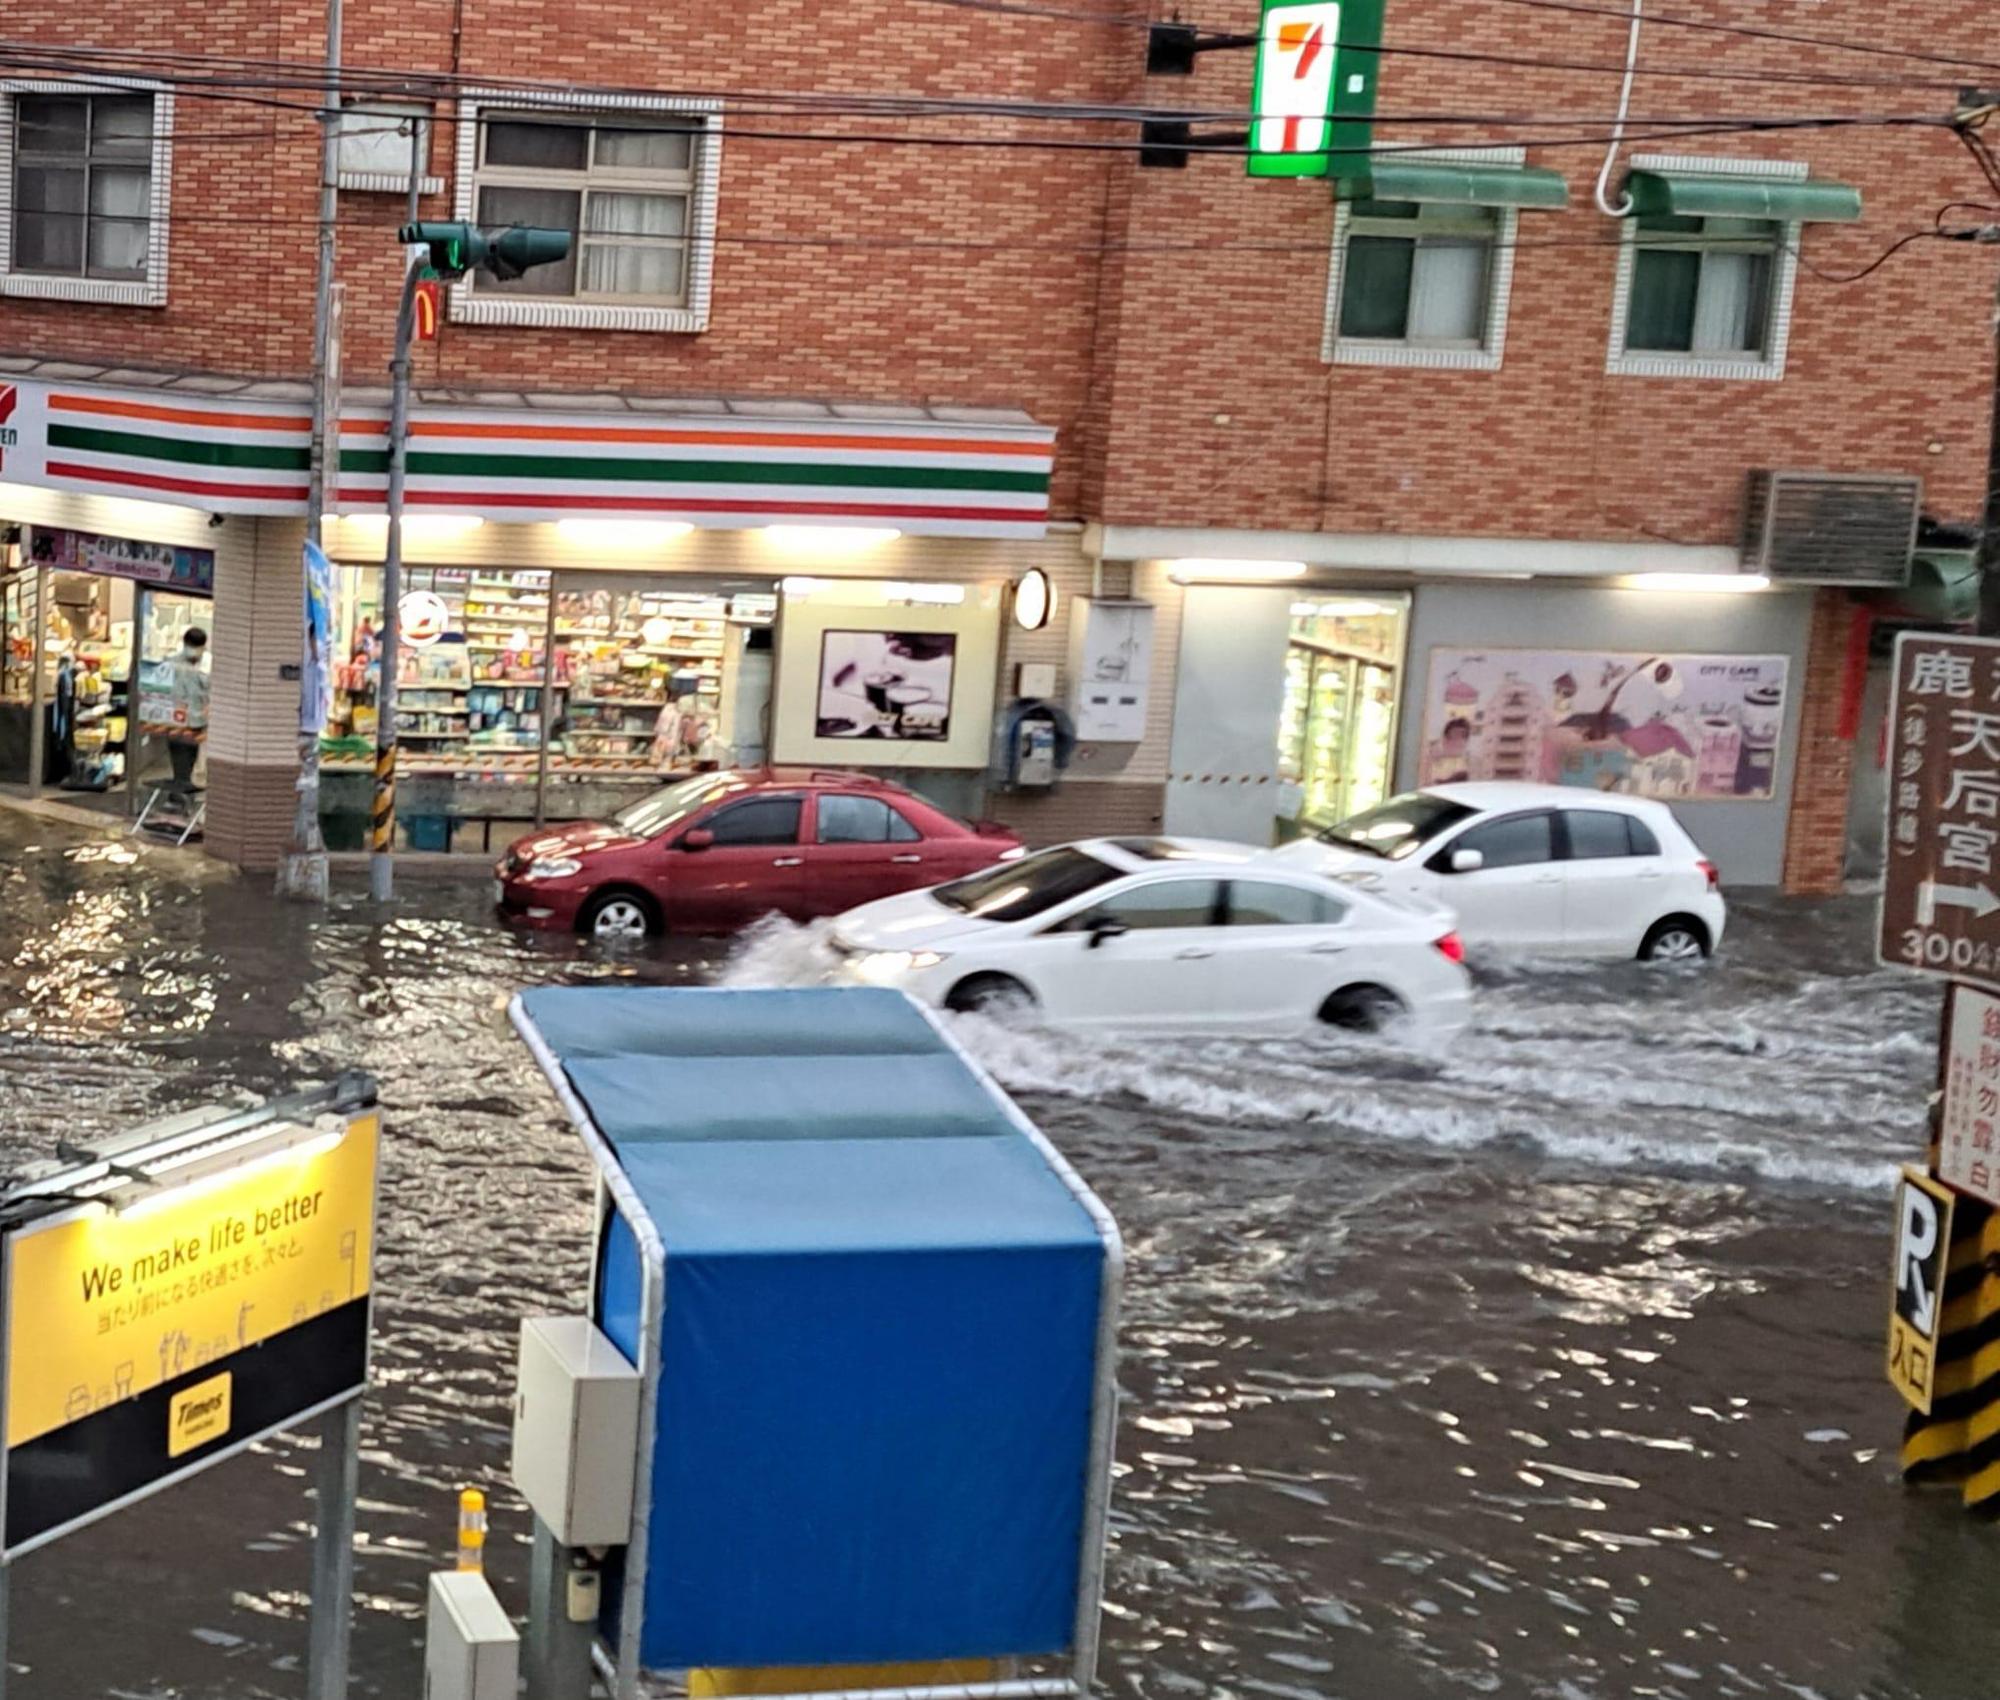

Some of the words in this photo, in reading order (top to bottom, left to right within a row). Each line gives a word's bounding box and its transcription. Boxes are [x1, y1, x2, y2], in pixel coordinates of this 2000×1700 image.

[1907, 649, 2000, 702] 鹿
[82, 1264, 122, 1302] We
[132, 1236, 200, 1284] make
[209, 1216, 245, 1254] life
[254, 1190, 323, 1236] better
[1887, 1327, 1928, 1397] 入口
[178, 1392, 224, 1427] Times
